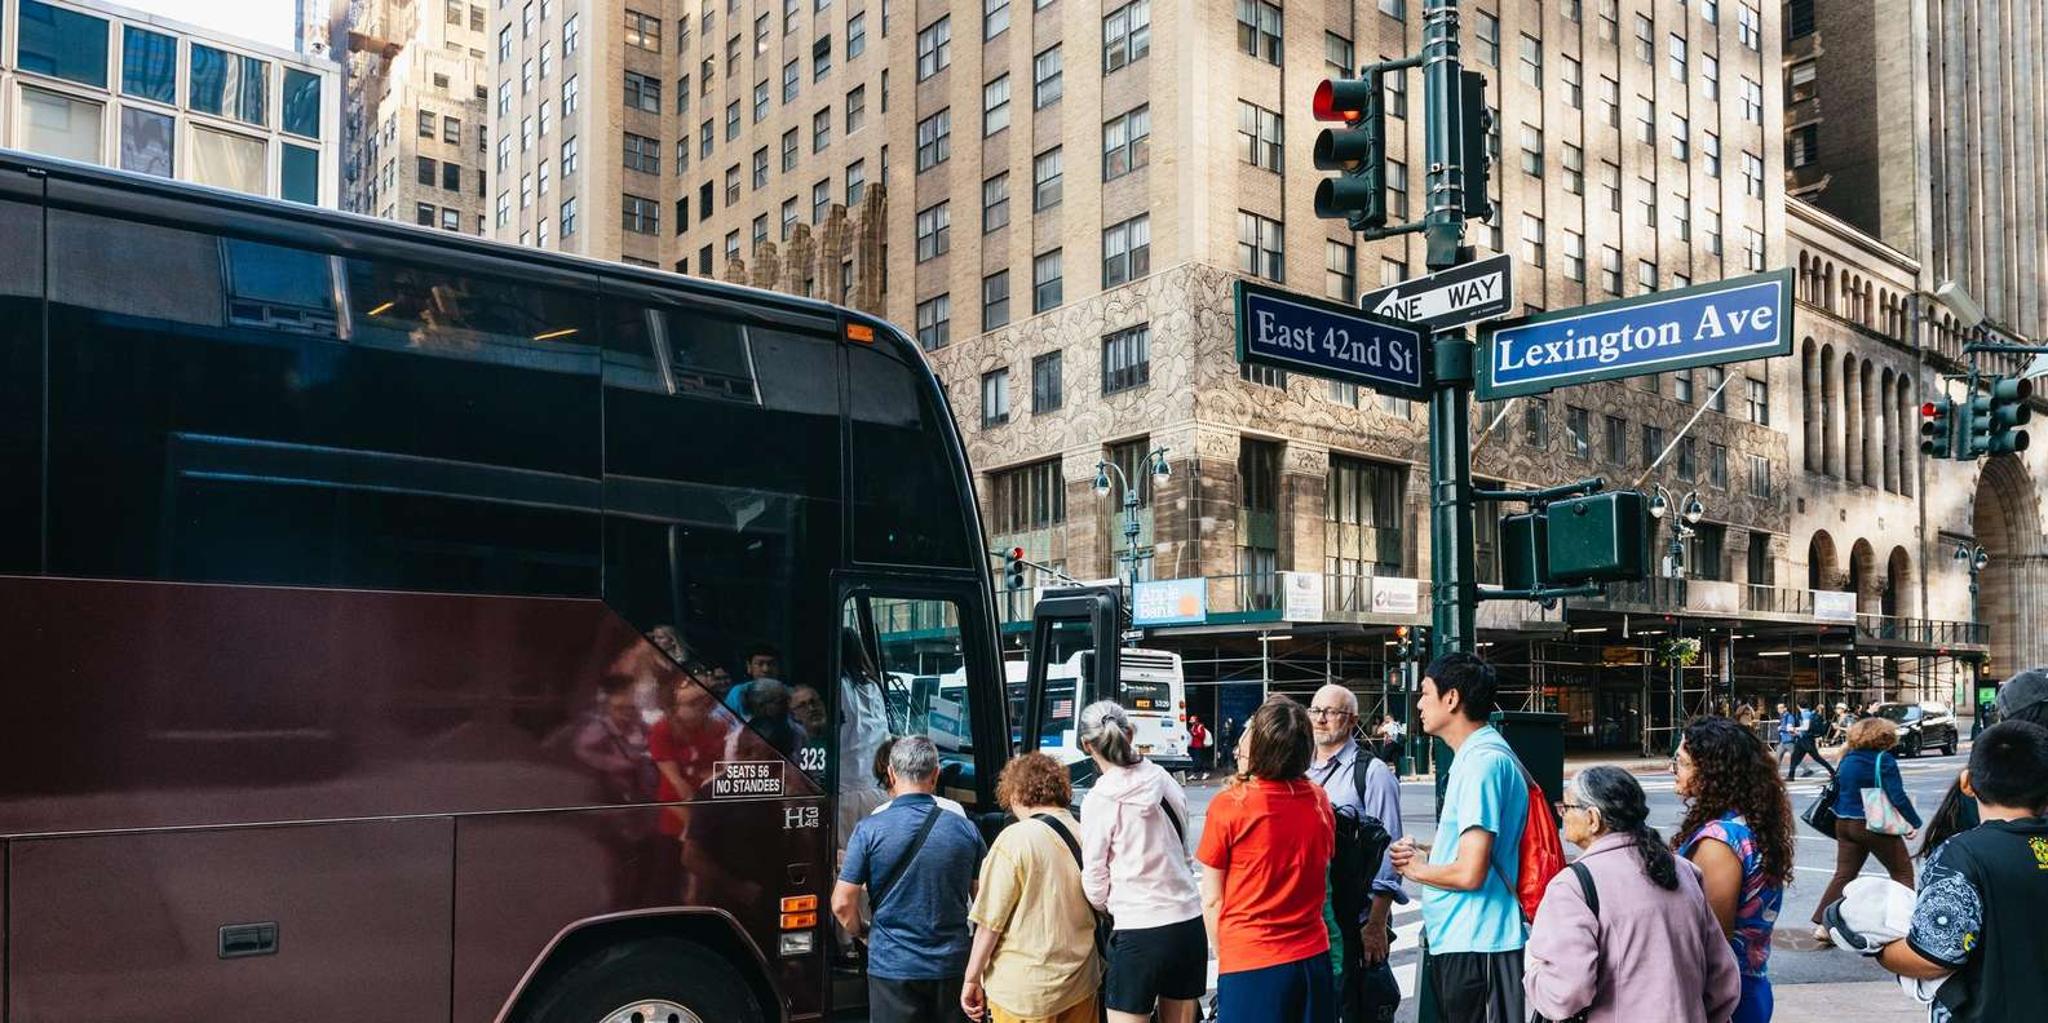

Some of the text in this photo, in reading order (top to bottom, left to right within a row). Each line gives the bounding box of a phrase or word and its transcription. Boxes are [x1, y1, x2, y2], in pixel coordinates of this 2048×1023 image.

[1380, 276, 1497, 320] ONE WAY
[1256, 309, 1414, 375] East 42nd St
[1499, 304, 1773, 372] Lexington Ave
[726, 765, 769, 779] SEATS 56
[800, 747, 826, 771] 323
[716, 778, 780, 793] NO STANDEES
